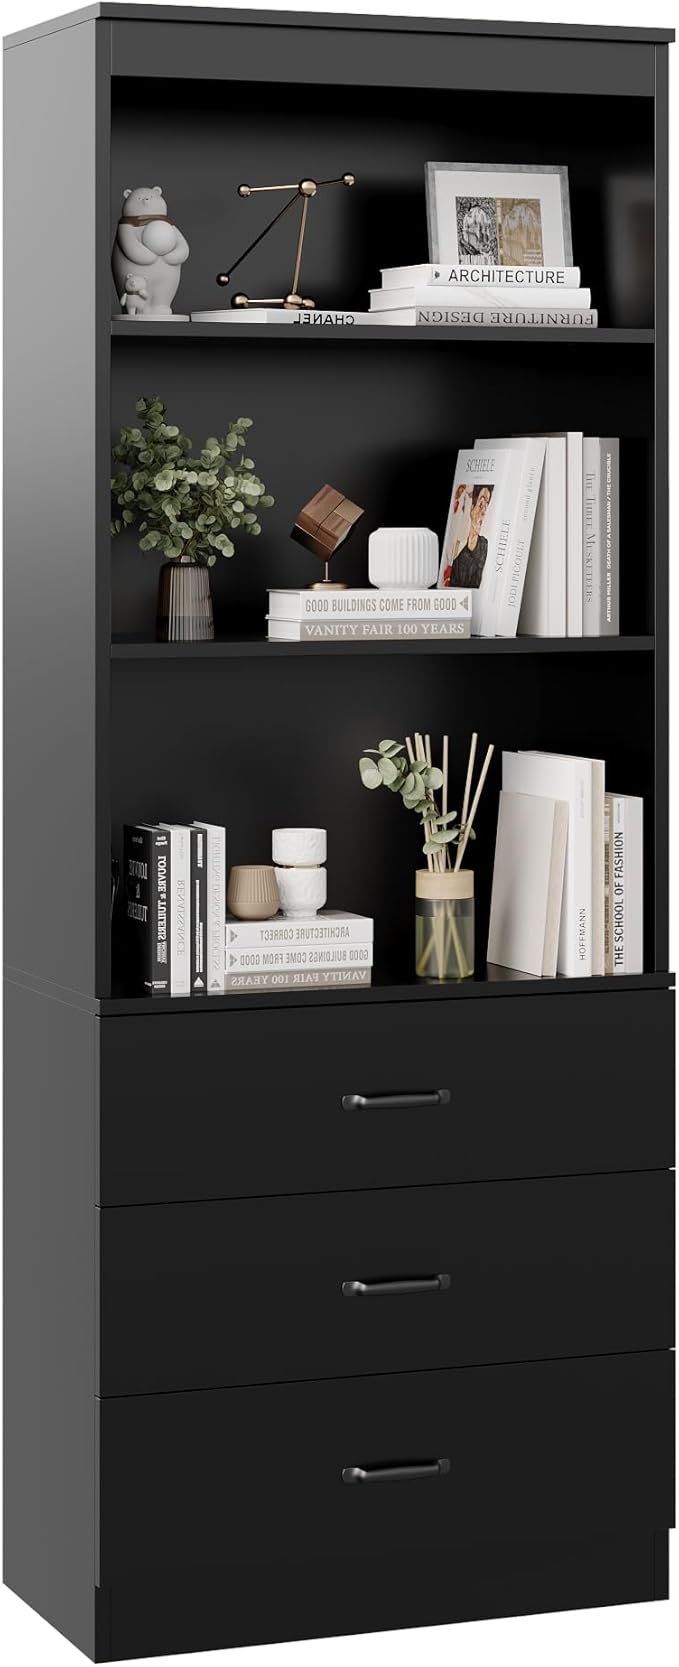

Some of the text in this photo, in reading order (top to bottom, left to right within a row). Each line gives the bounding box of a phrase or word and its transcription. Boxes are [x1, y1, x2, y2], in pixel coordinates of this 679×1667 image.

[448, 269, 565, 284] ARCHITECTURE
[418, 309, 594, 325] FURNITURE DESIGN
[465, 458, 496, 473] SCHIELE
[495, 519, 510, 573] SCHIELE
[305, 598, 457, 613] GOOD BUILDINGS COME FROM GOOD
[305, 623, 465, 636] VANITY FAIR 100 YEARS
[614, 832, 624, 967] THE SCHOOL OF FASHION
[578, 908, 587, 961] HOFFMANN
